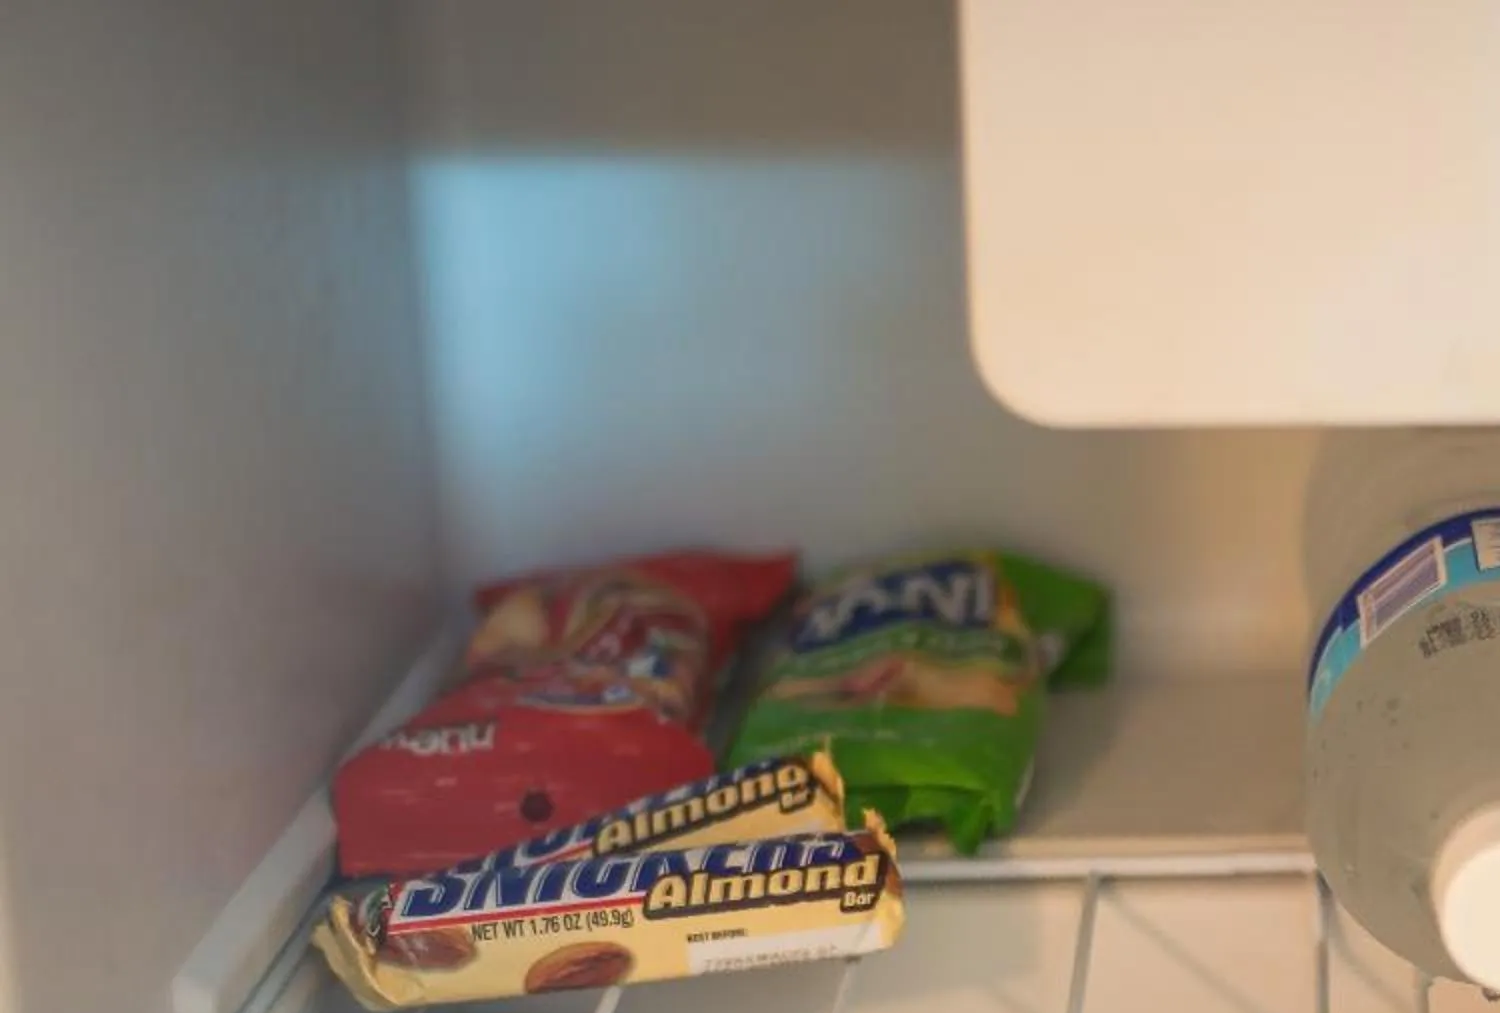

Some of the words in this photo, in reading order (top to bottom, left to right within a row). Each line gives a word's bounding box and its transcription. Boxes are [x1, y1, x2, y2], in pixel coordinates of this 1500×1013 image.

[648, 854, 880, 911] Almond
[843, 890, 875, 908] Bar
[471, 922, 499, 942] NET
[502, 919, 527, 939] WT
[530, 916, 560, 935] 1.76
[563, 913, 582, 930] OZ
[585, 908, 635, 931] (49.9g)
